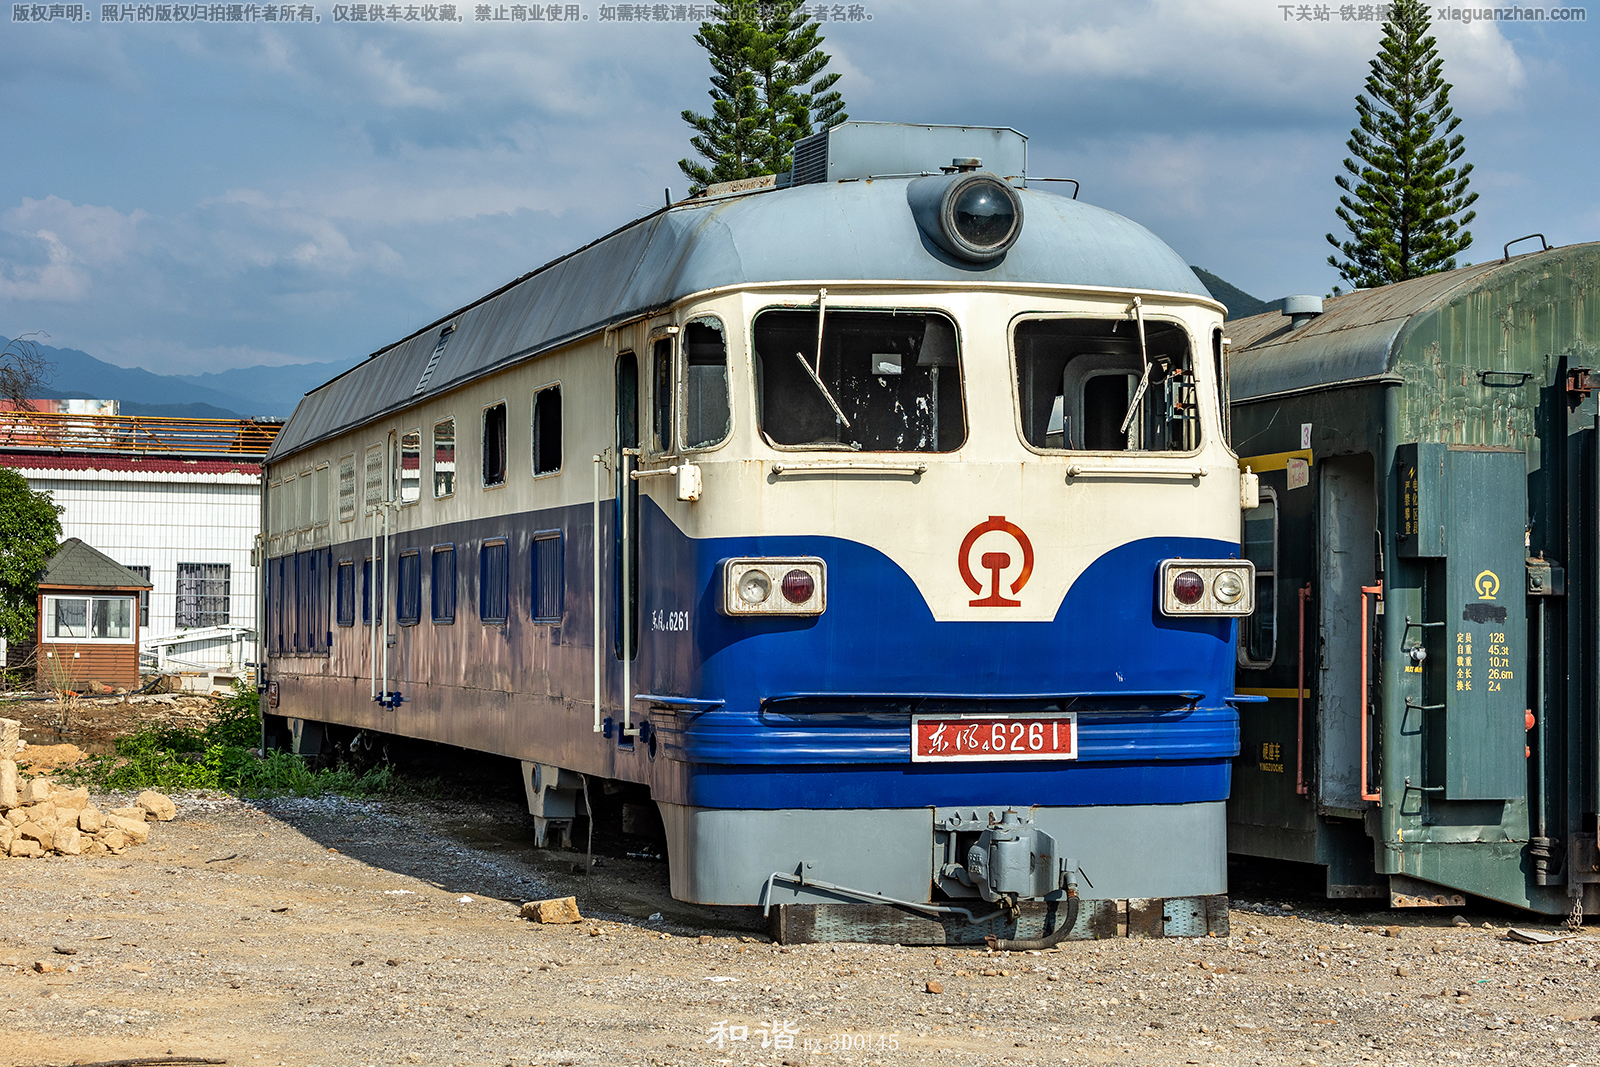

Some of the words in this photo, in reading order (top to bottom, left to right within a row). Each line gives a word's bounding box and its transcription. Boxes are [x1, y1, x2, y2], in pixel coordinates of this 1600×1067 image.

[1303, 426, 1310, 446] 3
[1456, 632, 1472, 643] 定员
[1488, 632, 1505, 643] 128
[1457, 644, 1472, 655] 自重
[1488, 644, 1509, 655] 45.3t
[1456, 656, 1472, 667] 载重
[1489, 656, 1509, 667] 10.7t
[1456, 668, 1472, 679] 全长
[1488, 668, 1514, 679] 26.6m
[1456, 680, 1472, 691] 换长
[1488, 680, 1501, 692] 2.4
[1262, 742, 1281, 761] 硬座车
[1259, 763, 1284, 773] YINGZUOCHE
